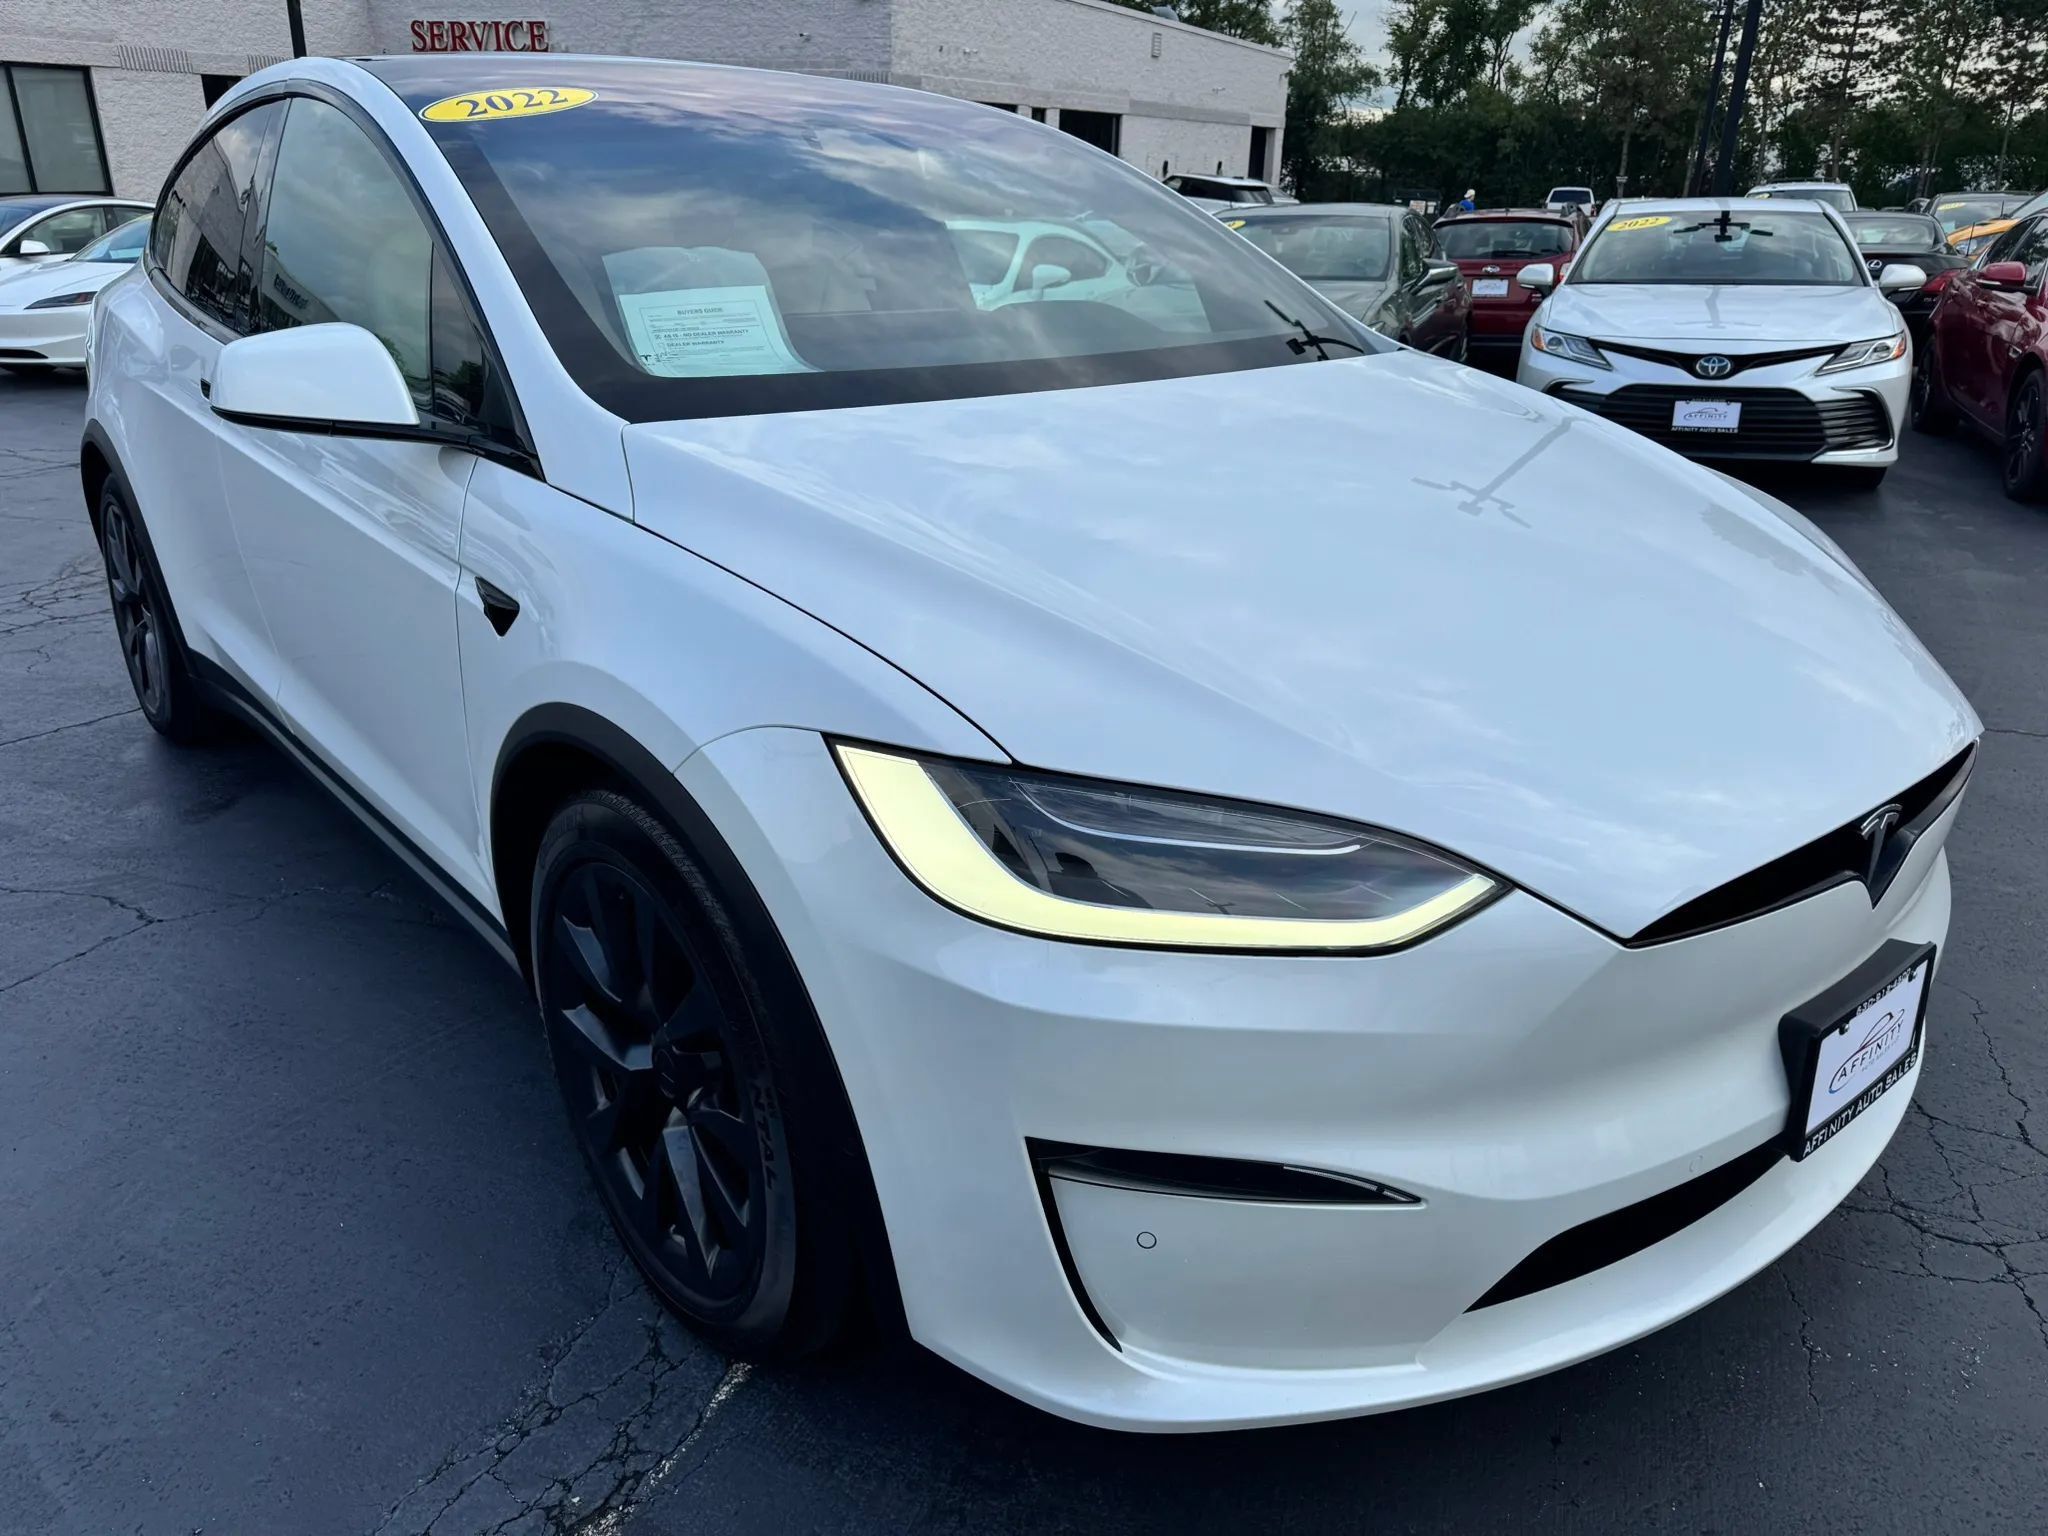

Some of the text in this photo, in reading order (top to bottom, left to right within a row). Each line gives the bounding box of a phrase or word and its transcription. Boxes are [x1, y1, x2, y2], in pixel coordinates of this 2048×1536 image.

[410, 20, 549, 52] SERVICE
[456, 89, 569, 117] 2022
[1617, 217, 1660, 229] 2022
[1838, 1019, 1904, 1082] AFFINITY
[1803, 1052, 1917, 1158] AFFINITY AUTO SALES
